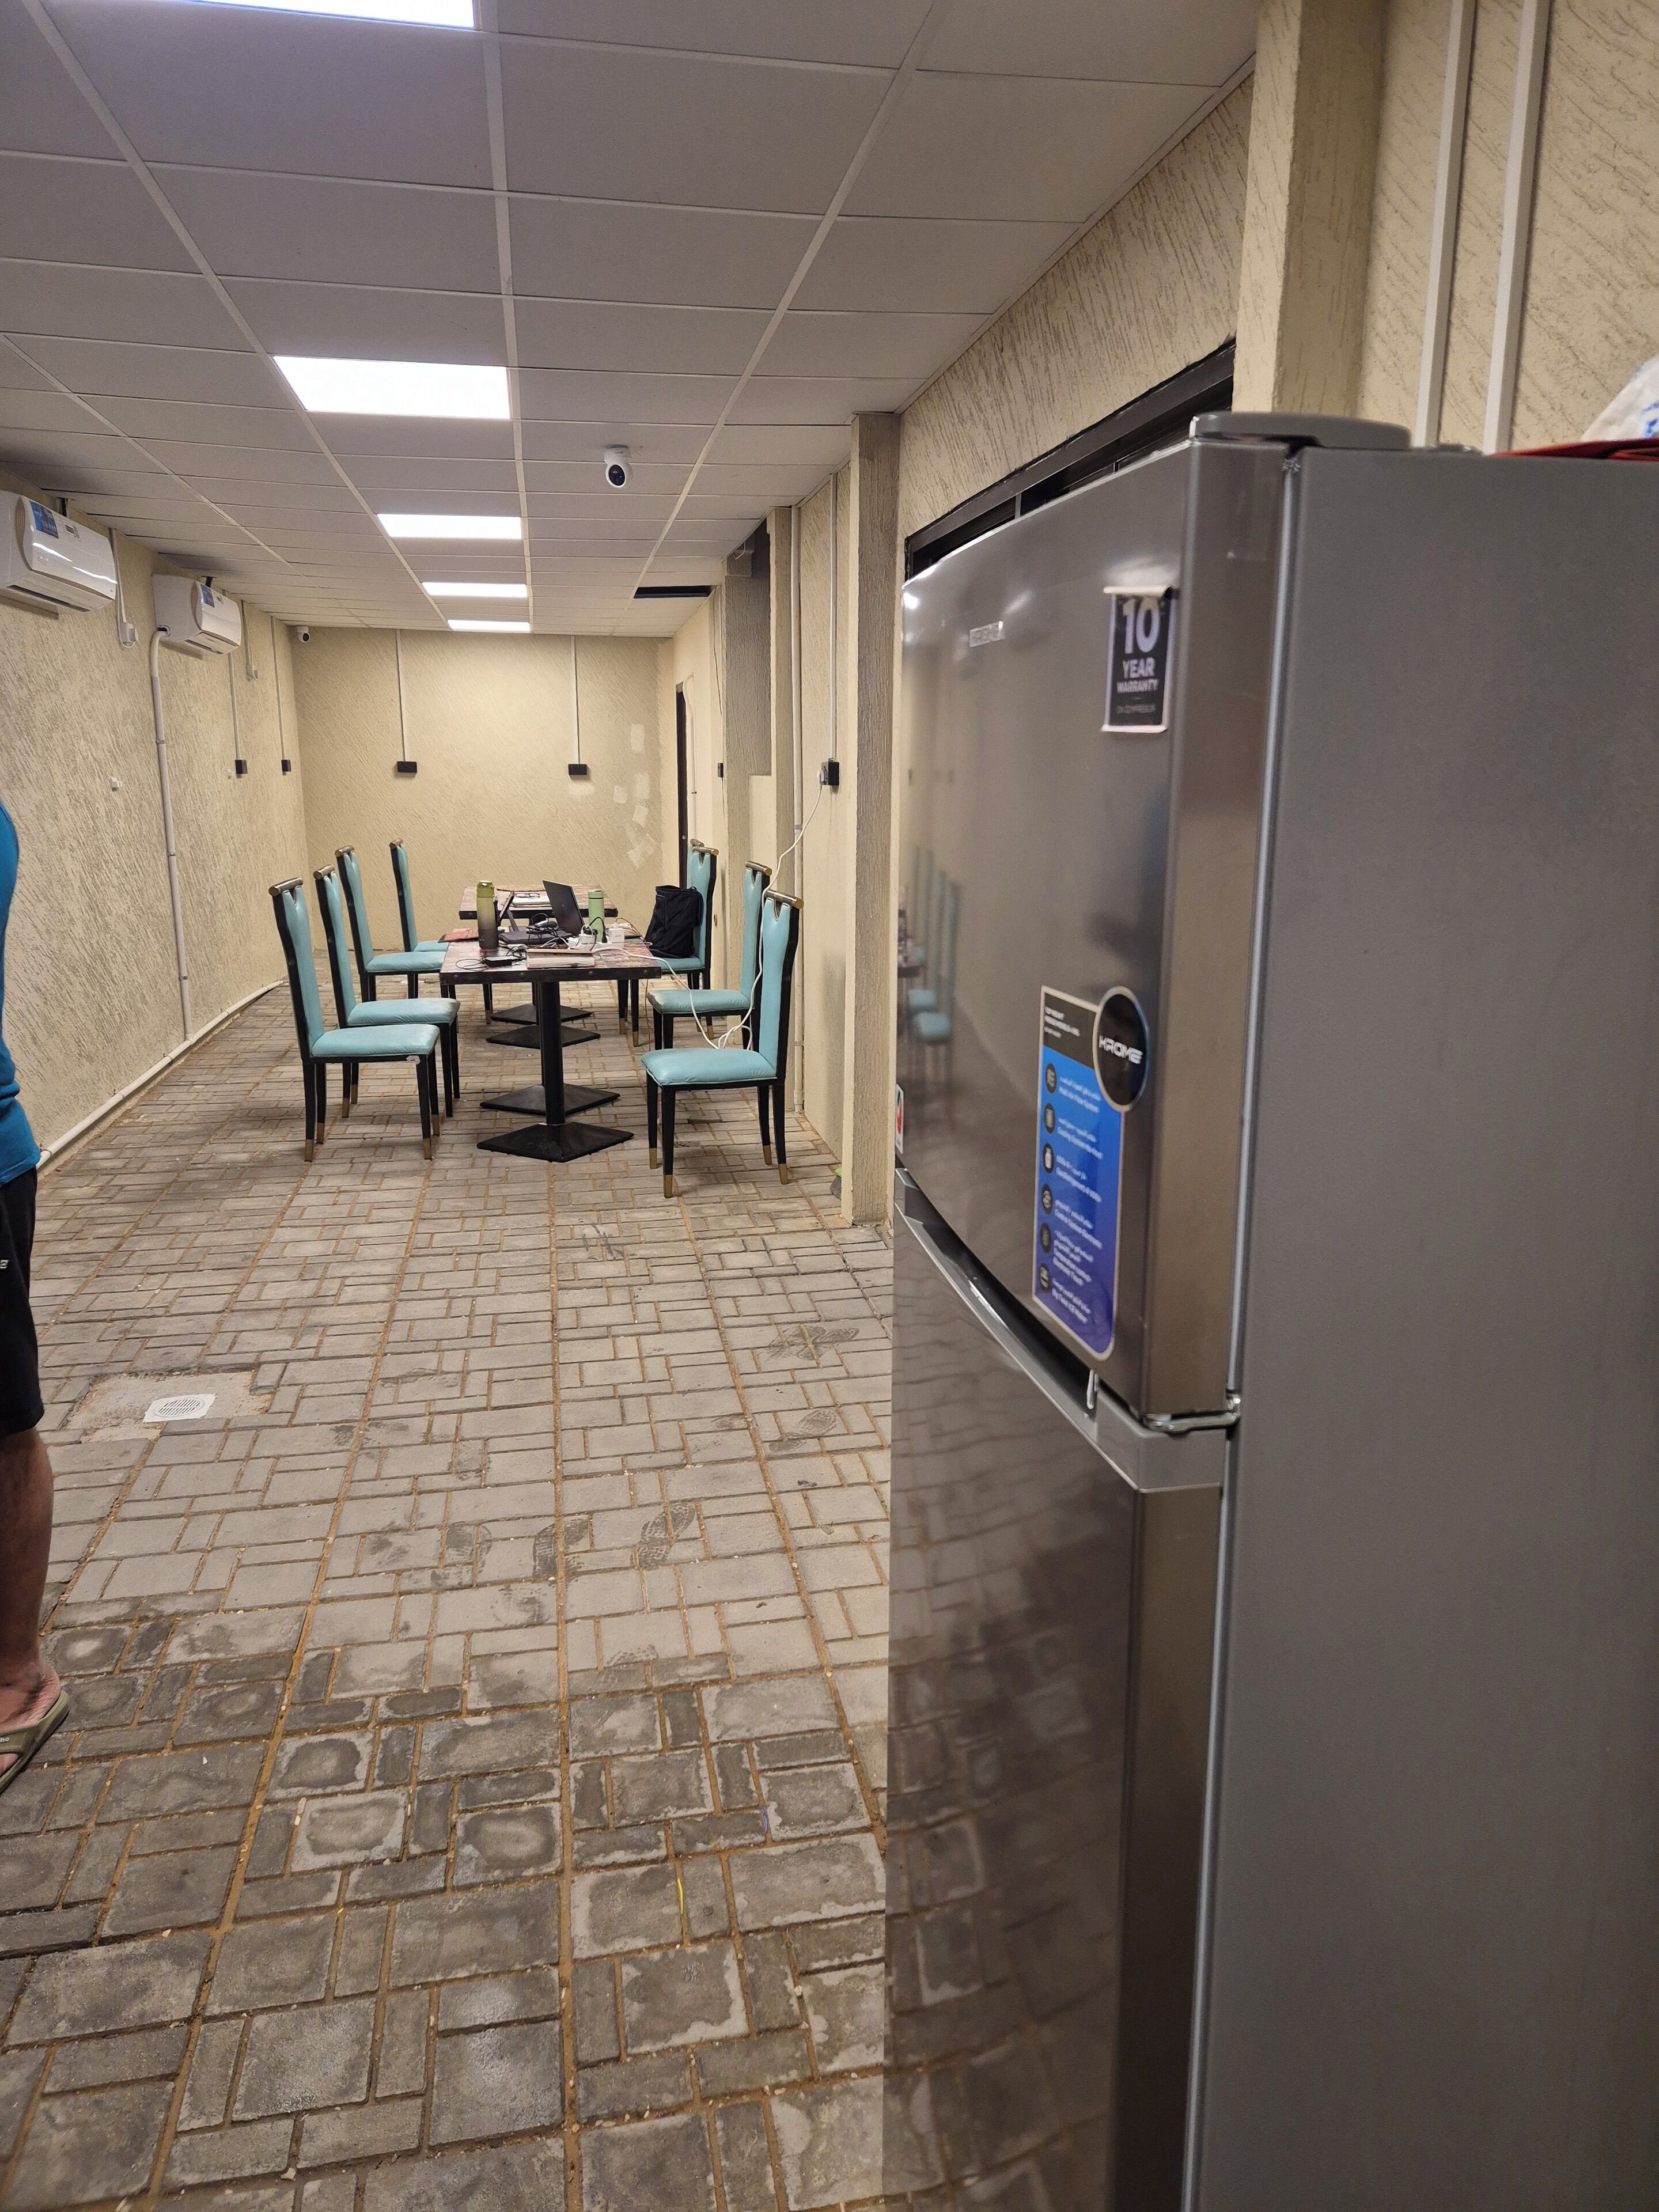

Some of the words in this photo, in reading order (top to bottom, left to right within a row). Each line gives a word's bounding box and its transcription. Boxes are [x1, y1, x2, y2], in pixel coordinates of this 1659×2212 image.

[1122, 597, 1160, 654] 10
[1123, 657, 1156, 678] YEAR
[1099, 1035, 1143, 1064] KROME
